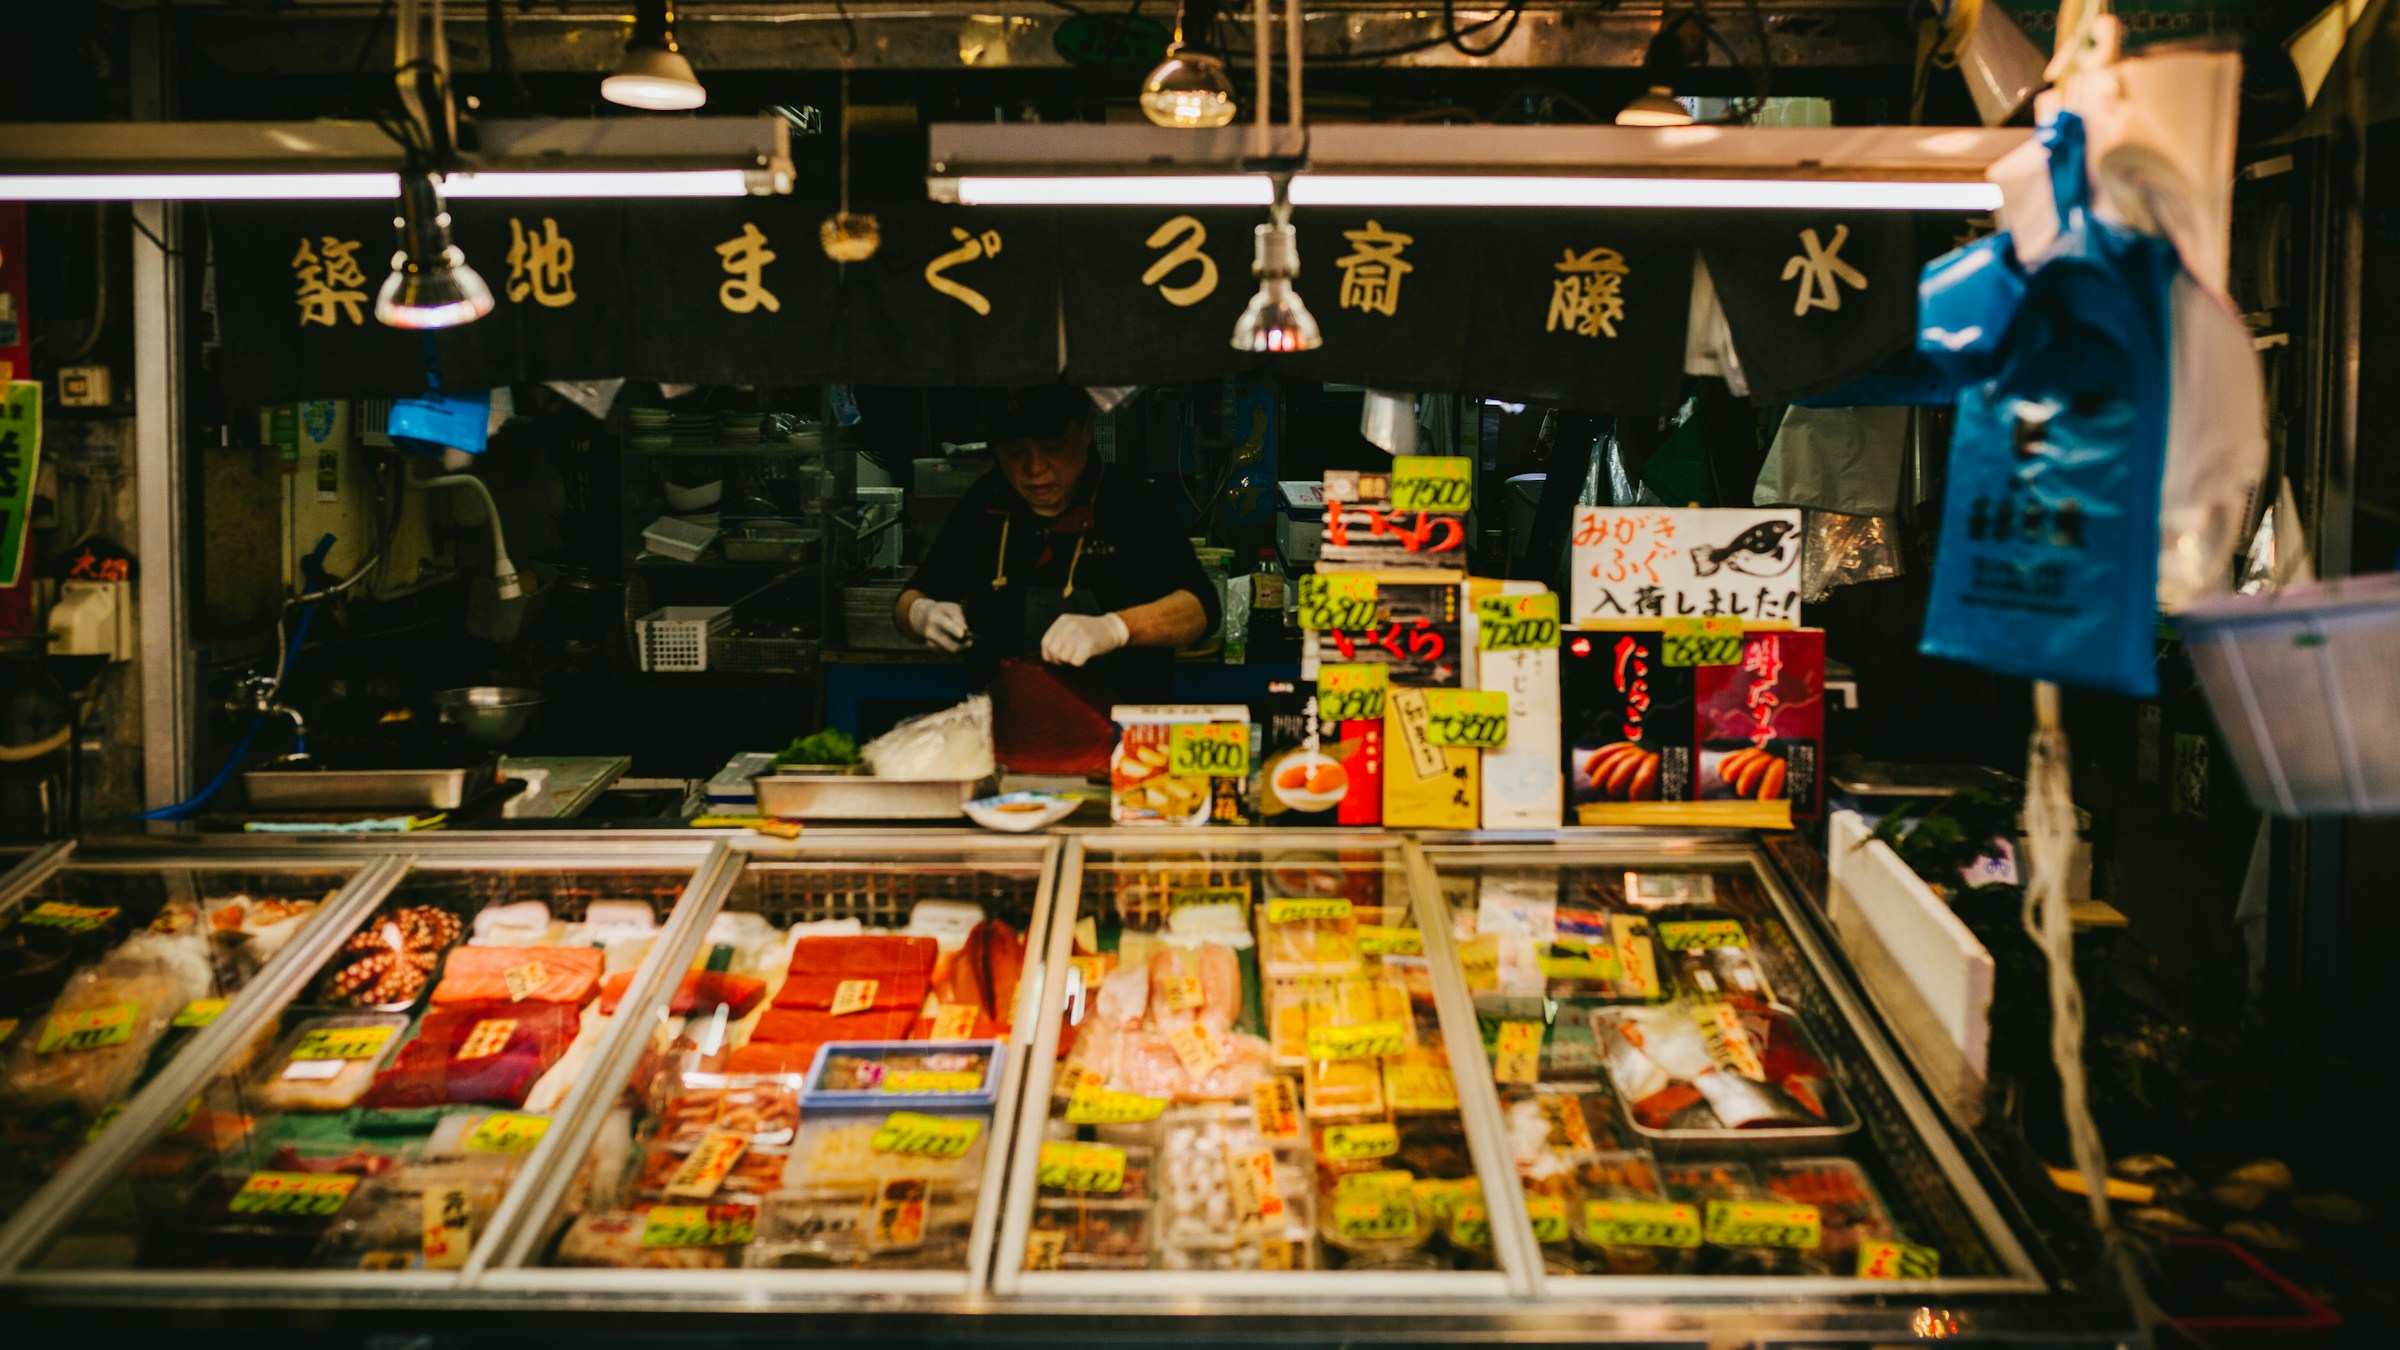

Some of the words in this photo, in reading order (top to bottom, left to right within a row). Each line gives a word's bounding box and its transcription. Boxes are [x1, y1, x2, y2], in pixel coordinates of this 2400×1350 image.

[1590, 547, 1678, 583] ふぐ
[1614, 635, 1651, 741] たらこ
